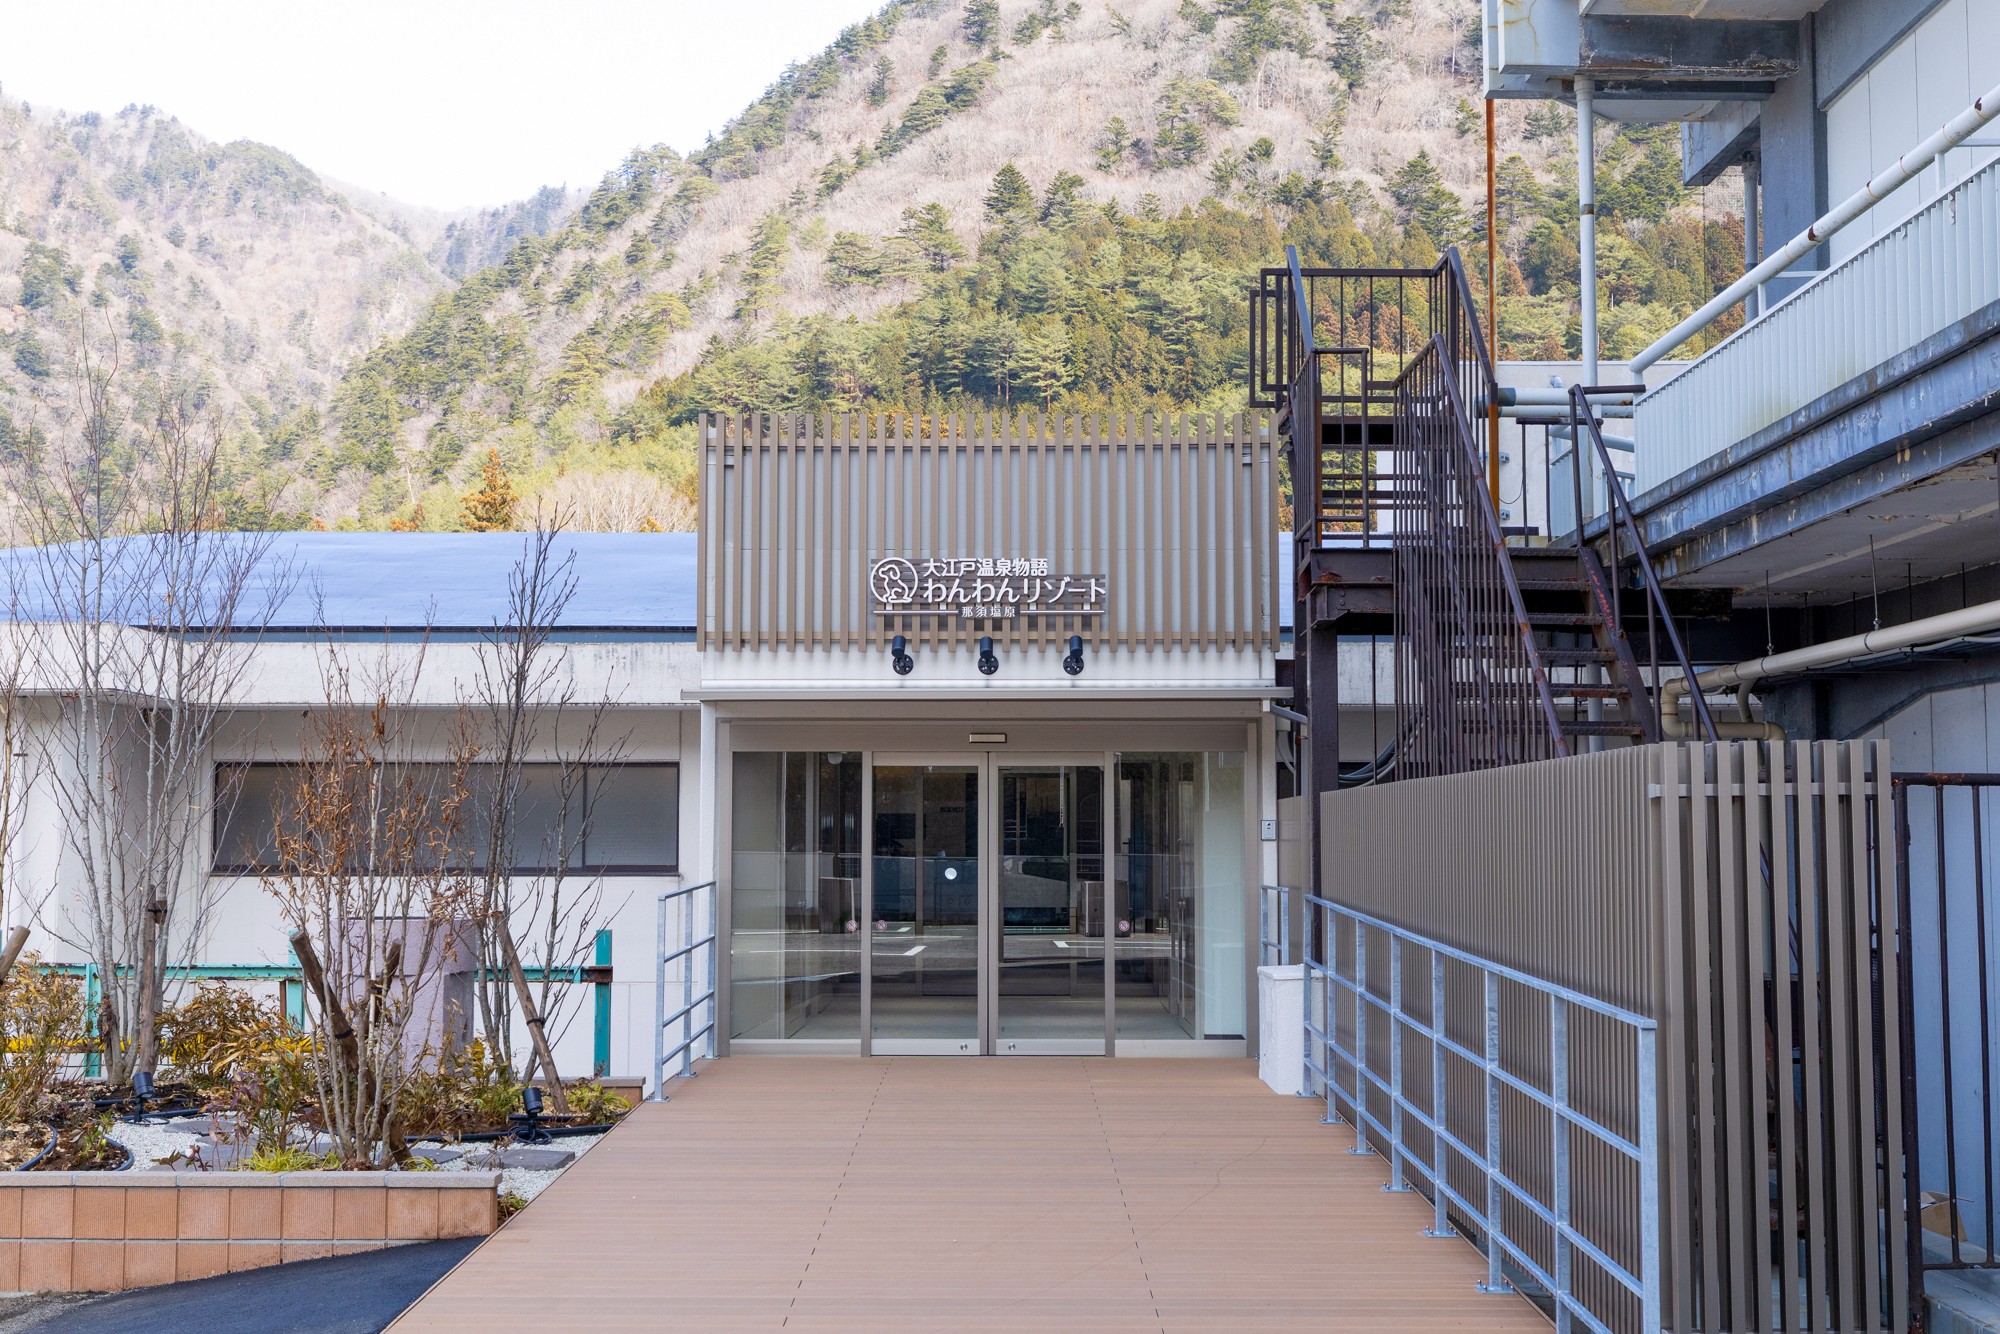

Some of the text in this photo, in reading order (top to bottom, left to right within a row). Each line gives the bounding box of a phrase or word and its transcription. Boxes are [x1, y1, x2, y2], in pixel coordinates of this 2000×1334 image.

[923, 558, 1048, 577] 大江戸温泉物語
[923, 577, 1106, 603] わんわんリゾート
[961, 606, 1016, 618] 那須塩原
